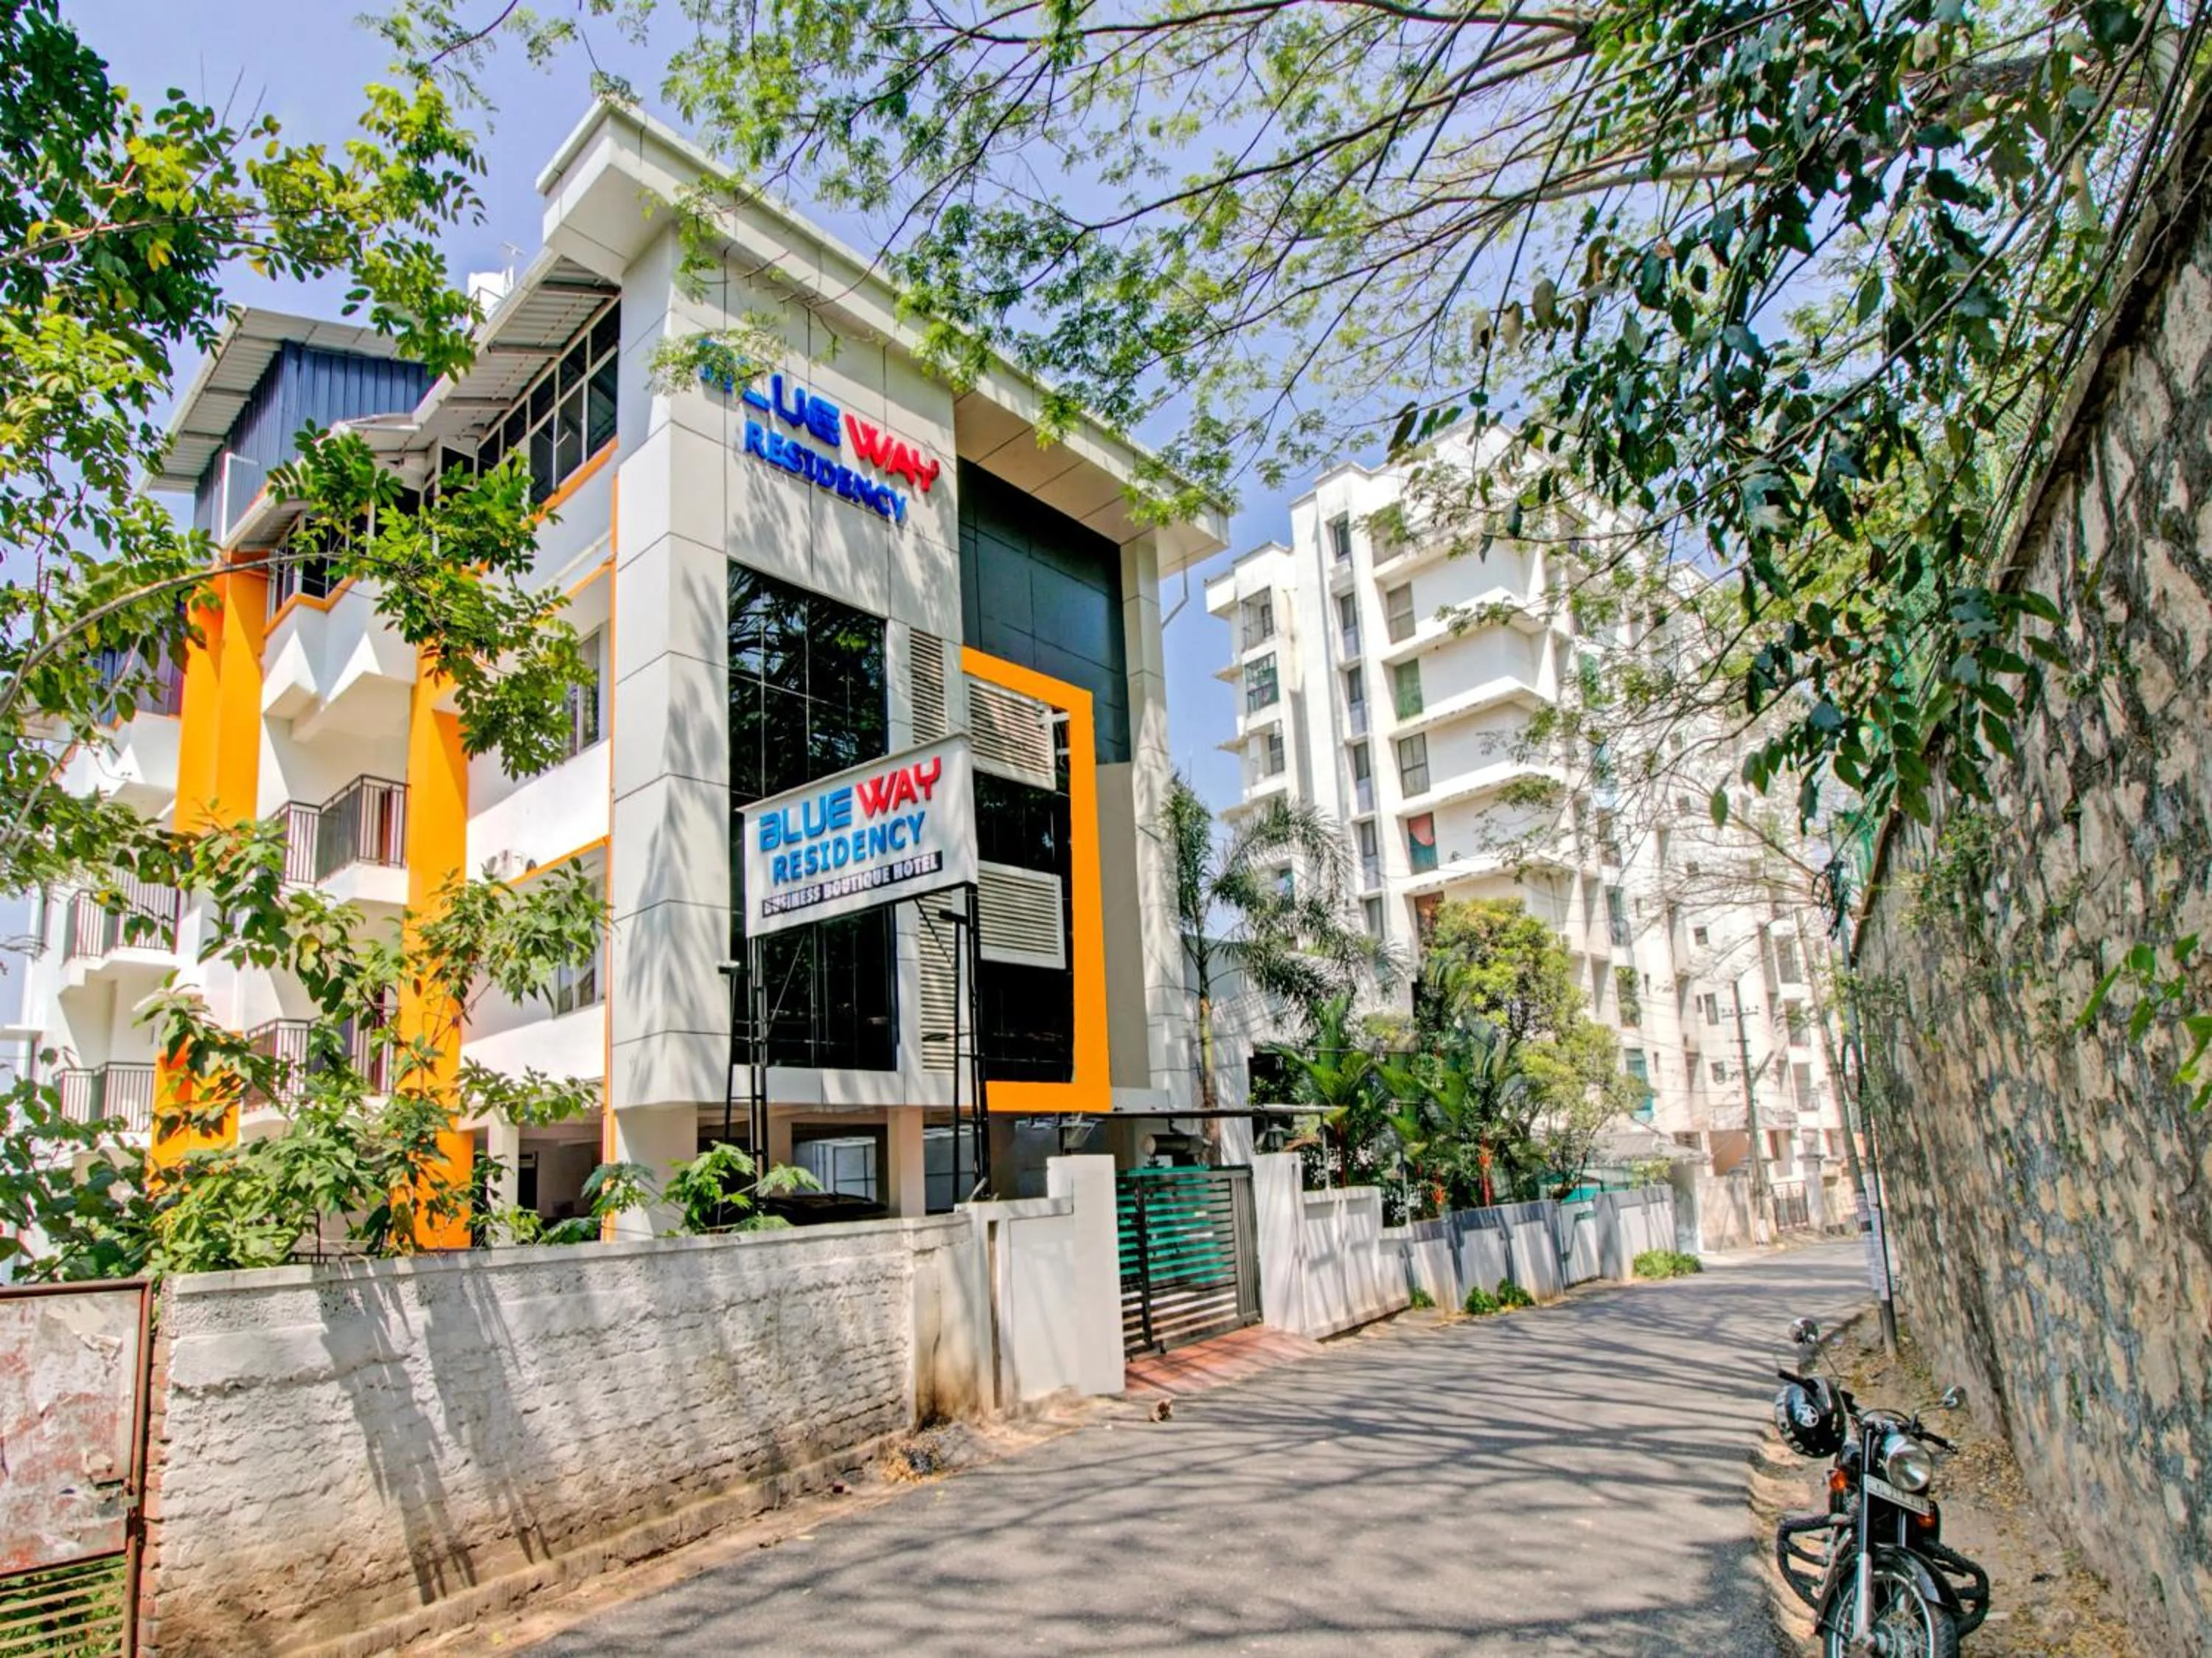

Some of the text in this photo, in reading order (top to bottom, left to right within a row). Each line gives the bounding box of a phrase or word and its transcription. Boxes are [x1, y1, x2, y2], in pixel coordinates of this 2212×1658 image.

[745, 418, 907, 522] RESIDENCY
[844, 412, 940, 493] WAY
[759, 756, 942, 852] BLUE WAY
[772, 810, 926, 887] RESIDENCY
[823, 867, 890, 899] BOUTIQUE
[893, 853, 939, 880] HOTEL
